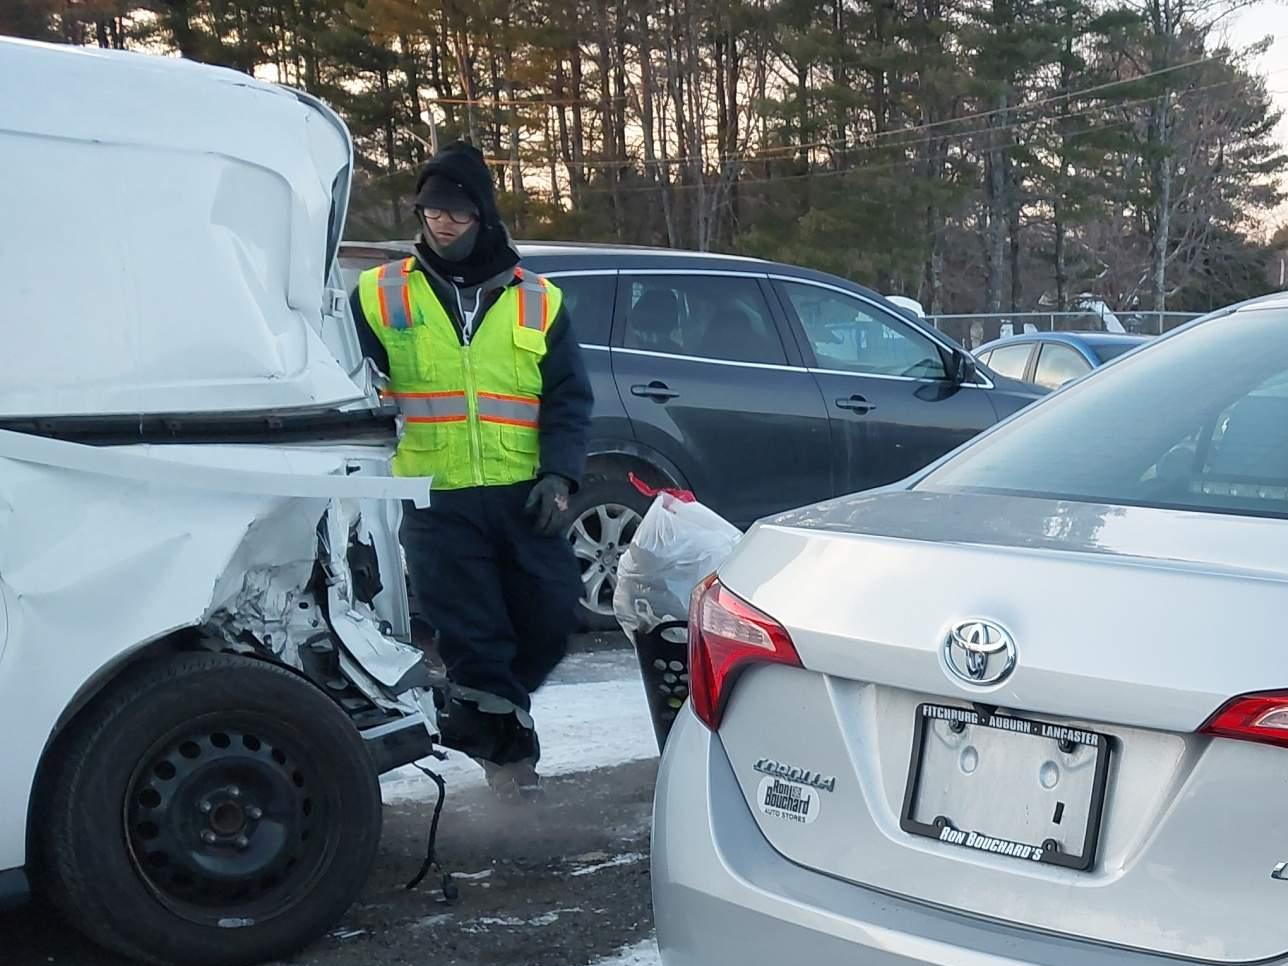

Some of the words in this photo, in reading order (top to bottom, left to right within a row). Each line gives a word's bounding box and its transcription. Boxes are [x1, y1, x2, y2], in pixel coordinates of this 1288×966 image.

[923, 704, 978, 724] FITCHBURG
[989, 715, 1031, 734] AUBURN
[1041, 724, 1098, 746] LANCASTER
[773, 779, 790, 795] Ron
[764, 786, 810, 815] Bouchard
[764, 808, 781, 817] AUTO
[782, 812, 806, 823] STORES
